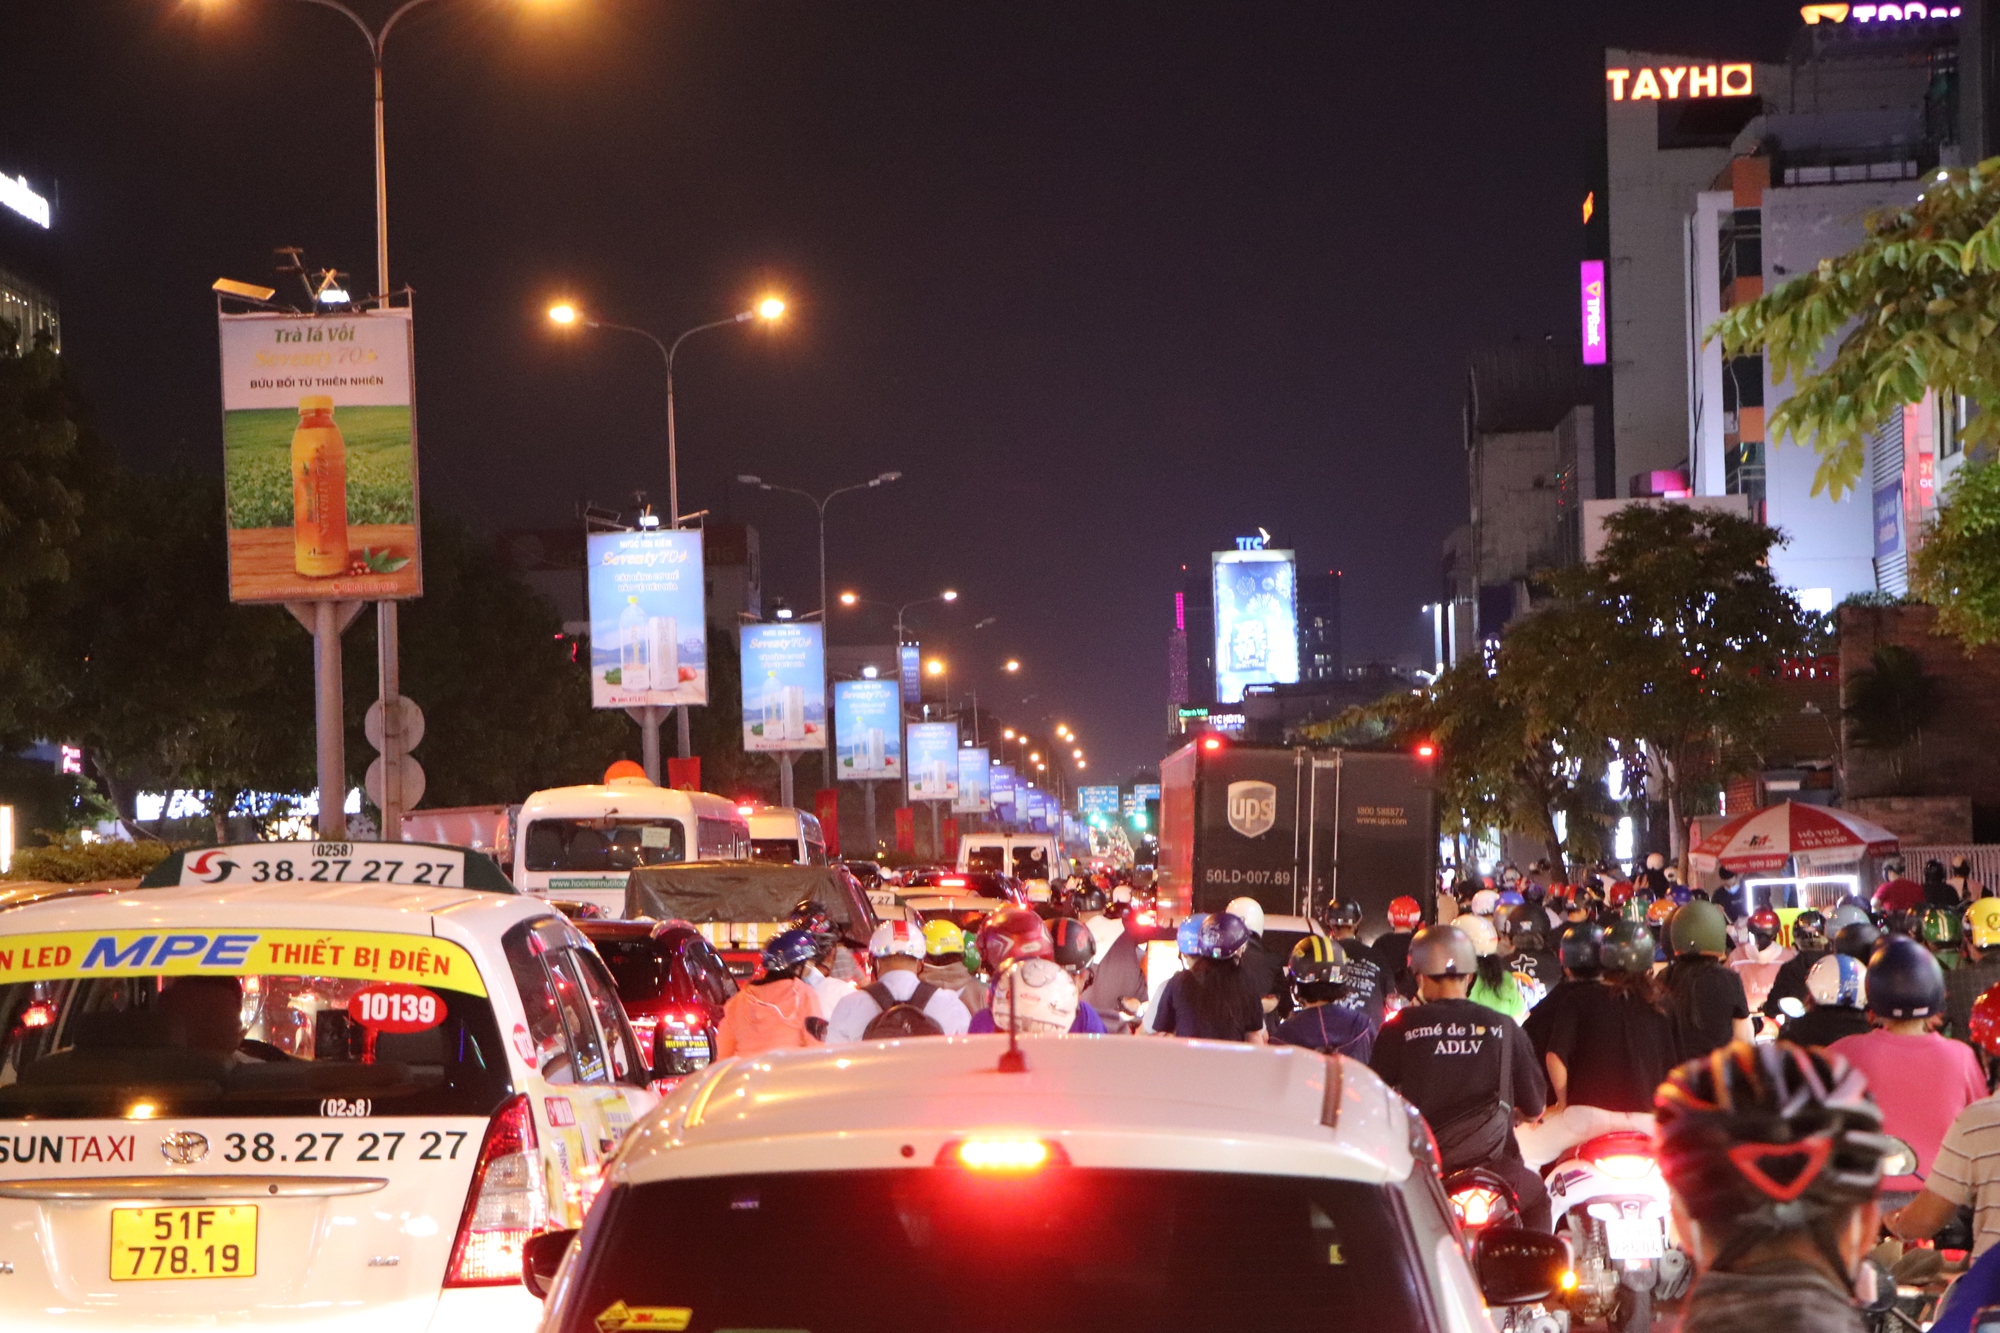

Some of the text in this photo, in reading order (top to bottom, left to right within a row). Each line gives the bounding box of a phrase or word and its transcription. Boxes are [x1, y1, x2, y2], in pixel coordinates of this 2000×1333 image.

[1606, 63, 1752, 100] TAYHO
[275, 327, 302, 343] Trà
[306, 325, 322, 343] lá
[602, 551, 659, 567] Seventy
[1231, 798, 1273, 828] ups
[311, 843, 354, 857] (0258)
[361, 860, 404, 882] 27
[413, 862, 455, 885] 27
[1206, 869, 1291, 886] 50LD-007.89
[22, 945, 72, 970] LED
[79, 934, 260, 970] MPE
[268, 937, 451, 977] THIẾT BỊ ĐIỆN
[358, 991, 436, 1024] 10139
[1404, 1023, 1443, 1041] acmé
[1447, 1022, 1467, 1036] de
[1434, 1040, 1483, 1055] ADLV
[356, 1131, 406, 1162] 27
[419, 1130, 469, 1160] 27
[154, 1210, 215, 1241] 51F
[128, 1244, 240, 1275] 778.19
